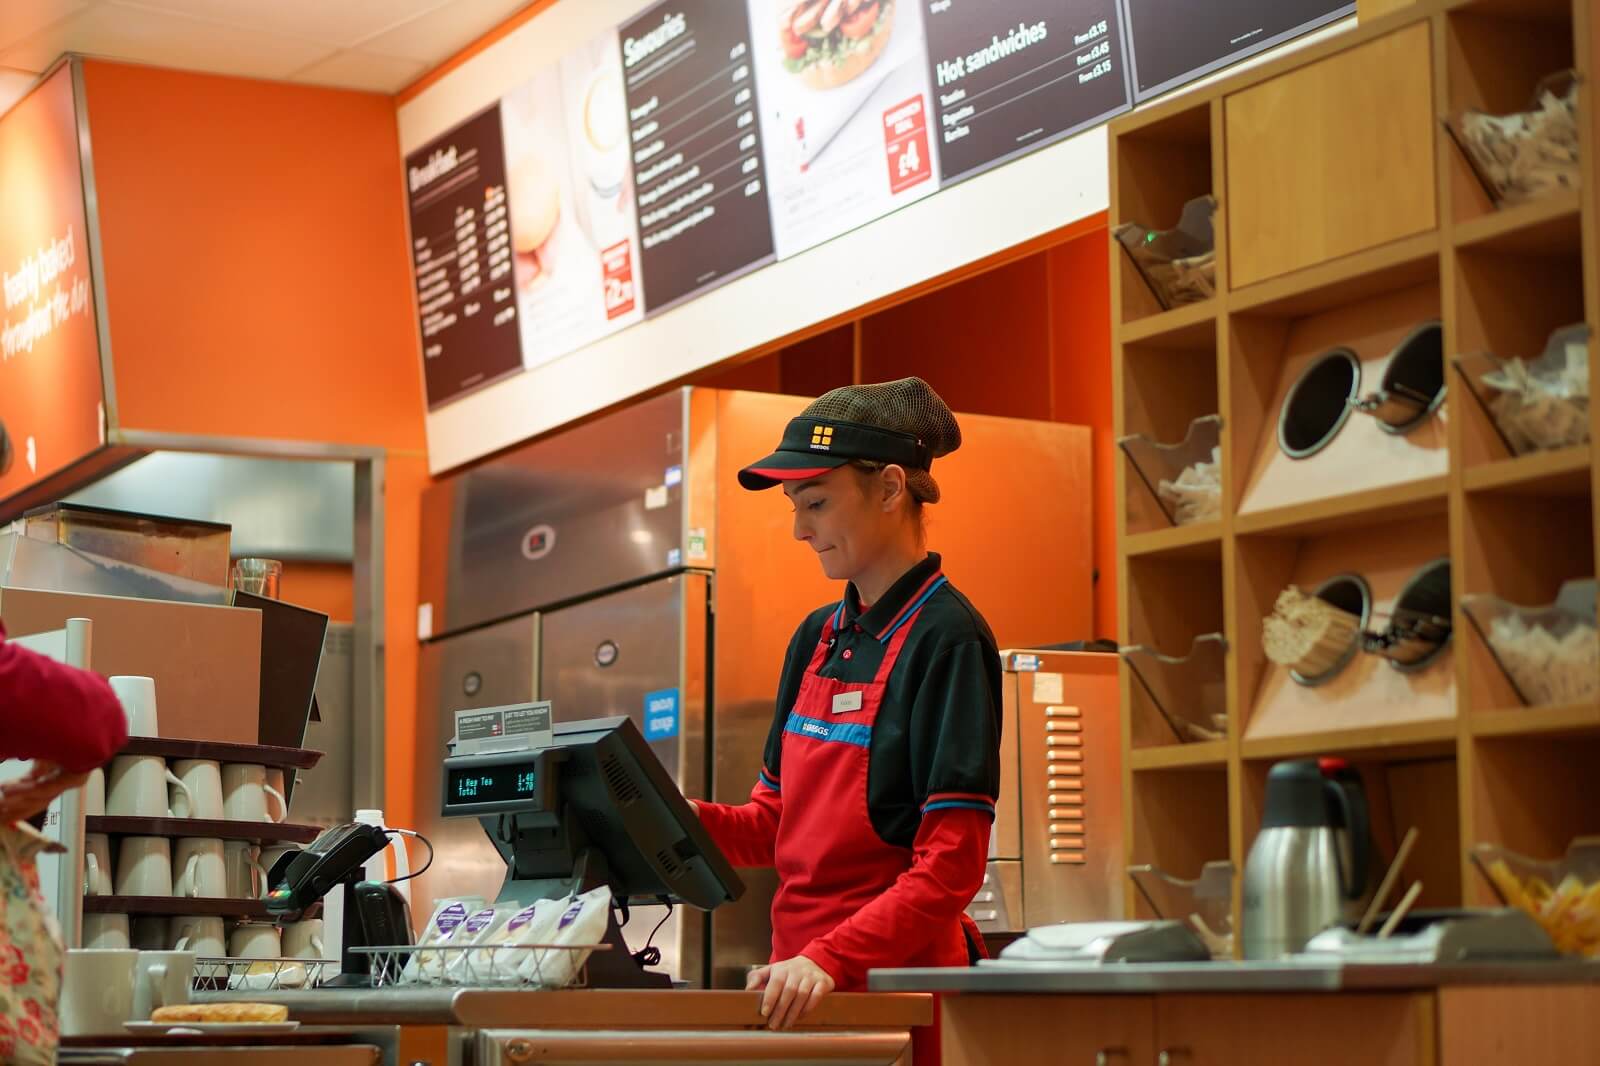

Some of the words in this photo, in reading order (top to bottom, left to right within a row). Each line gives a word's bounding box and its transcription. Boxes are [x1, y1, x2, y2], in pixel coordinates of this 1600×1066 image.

[623, 12, 686, 67] Savouries
[936, 56, 966, 87] Hot
[965, 21, 1047, 73] sandwiches
[898, 139, 921, 178] £4
[458, 786, 477, 797] Total
